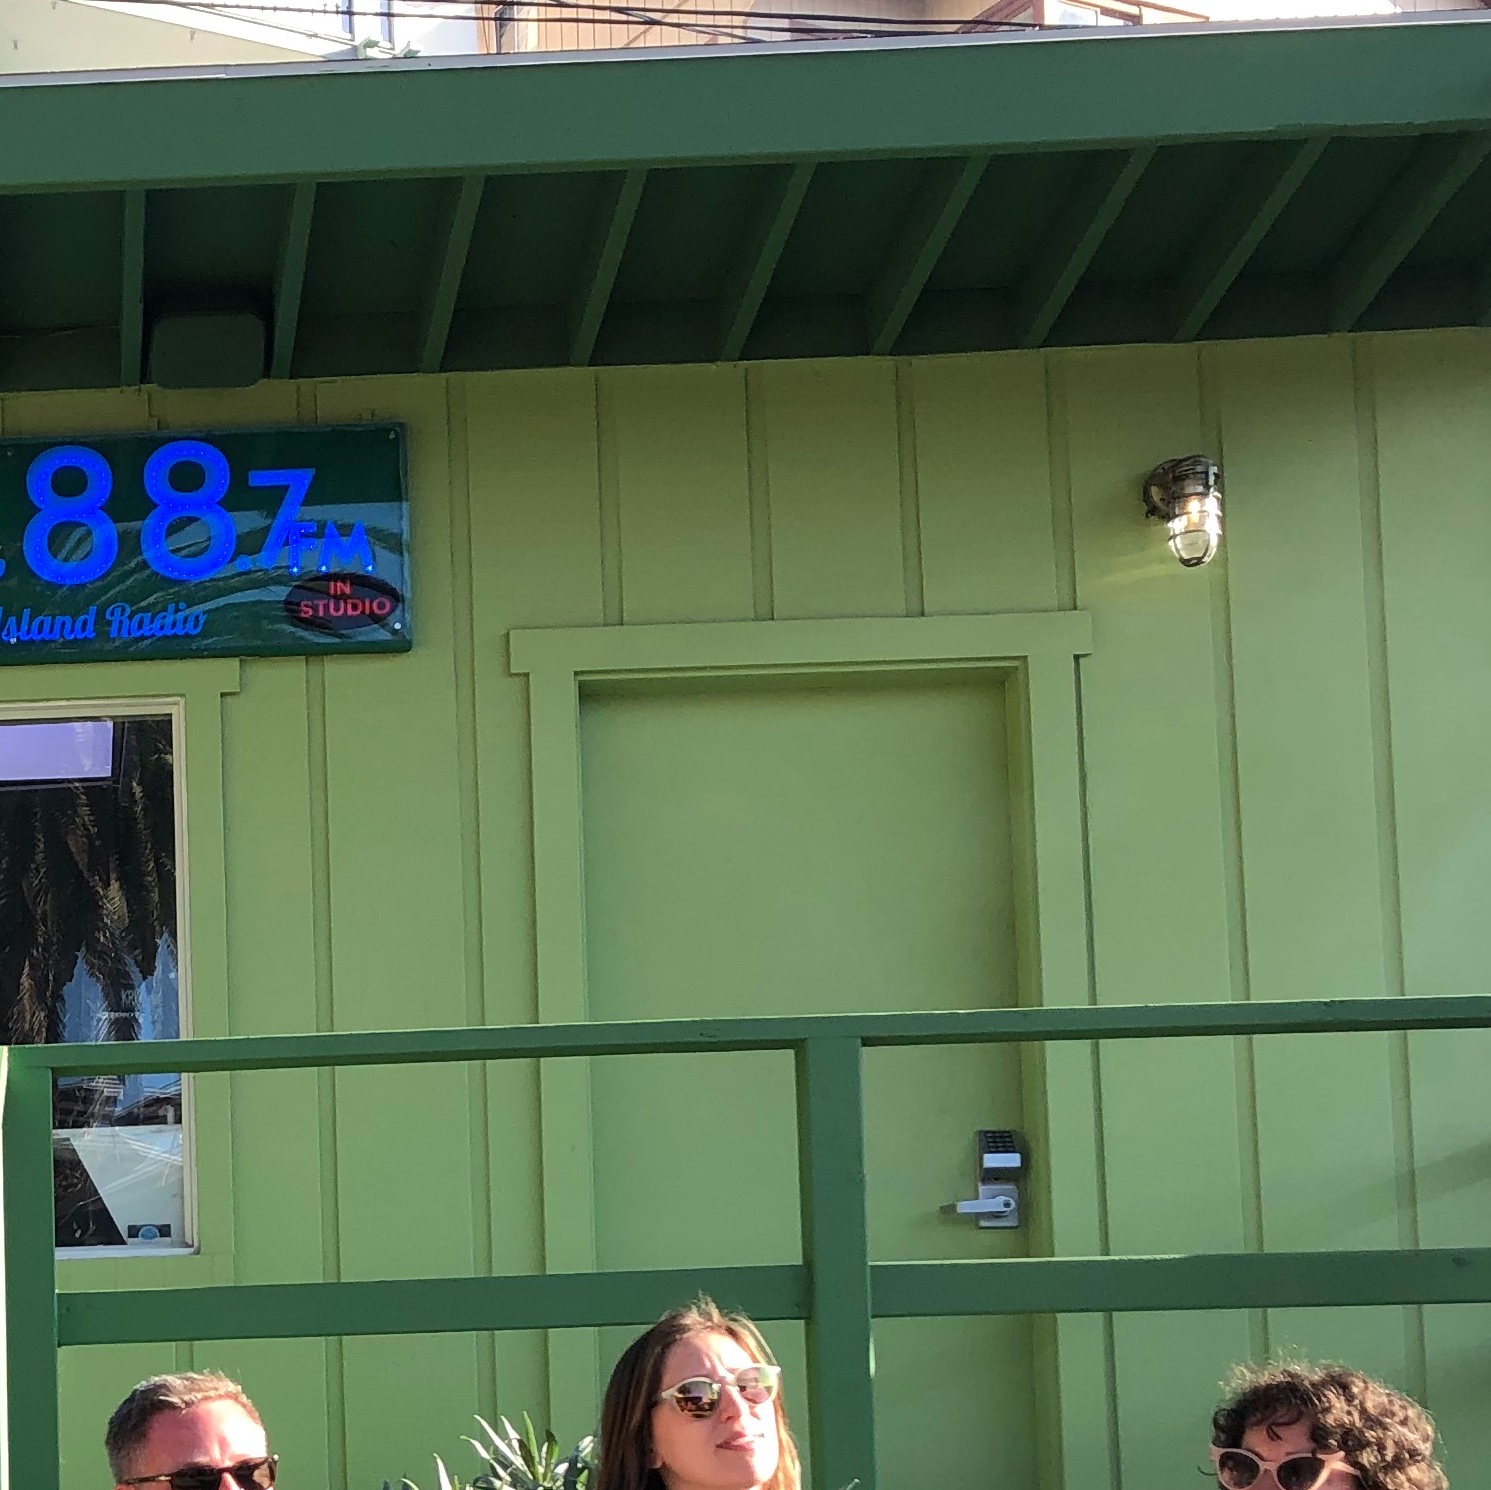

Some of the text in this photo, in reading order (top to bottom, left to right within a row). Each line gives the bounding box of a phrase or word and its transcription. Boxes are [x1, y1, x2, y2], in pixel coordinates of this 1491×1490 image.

[25, 439, 317, 586] 88.7
[288, 519, 376, 576] FM
[328, 579, 352, 596] IN
[105, 602, 208, 638] Radio
[299, 596, 393, 618] STUDIO
